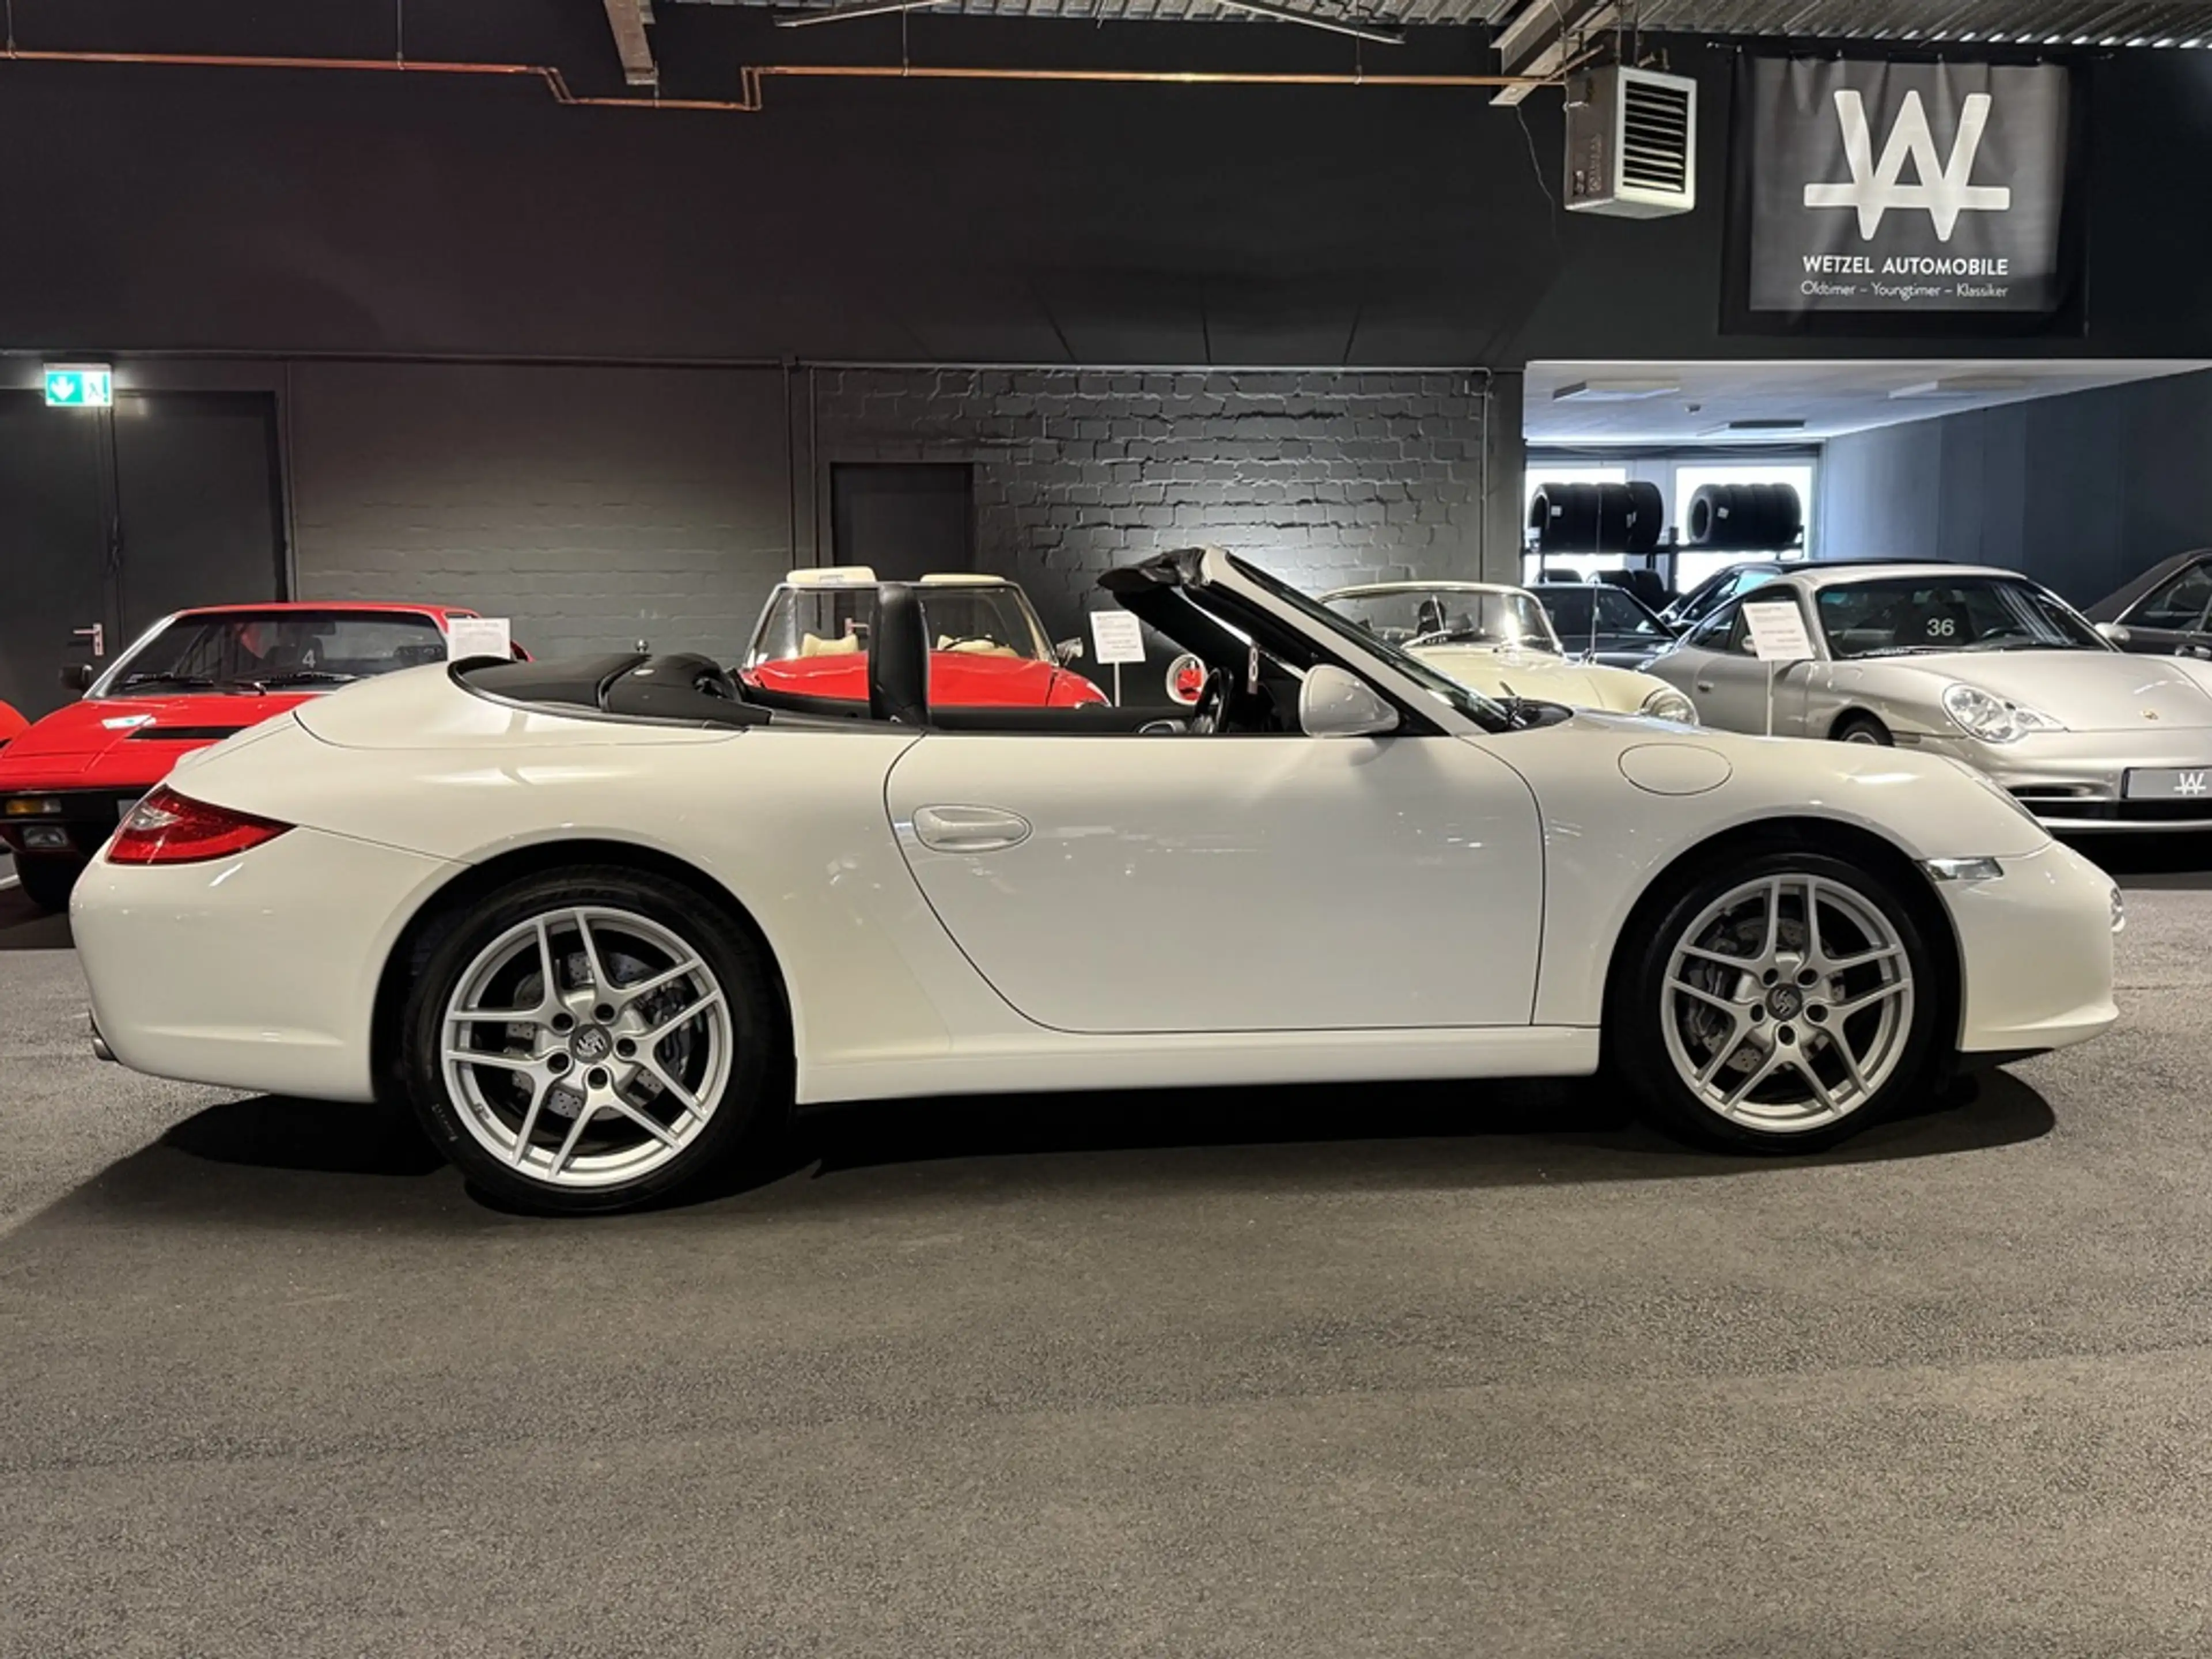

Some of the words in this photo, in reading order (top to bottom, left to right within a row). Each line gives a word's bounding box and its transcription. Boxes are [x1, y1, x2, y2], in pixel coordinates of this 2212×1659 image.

[1802, 255, 1874, 274] WETZEL
[1881, 257, 2009, 275] AUTOMOBILE
[1870, 281, 1941, 301] Youngtimer
[1957, 282, 2008, 297] Klassiker
[1927, 618, 1955, 636] 36
[302, 648, 316, 668] 4
